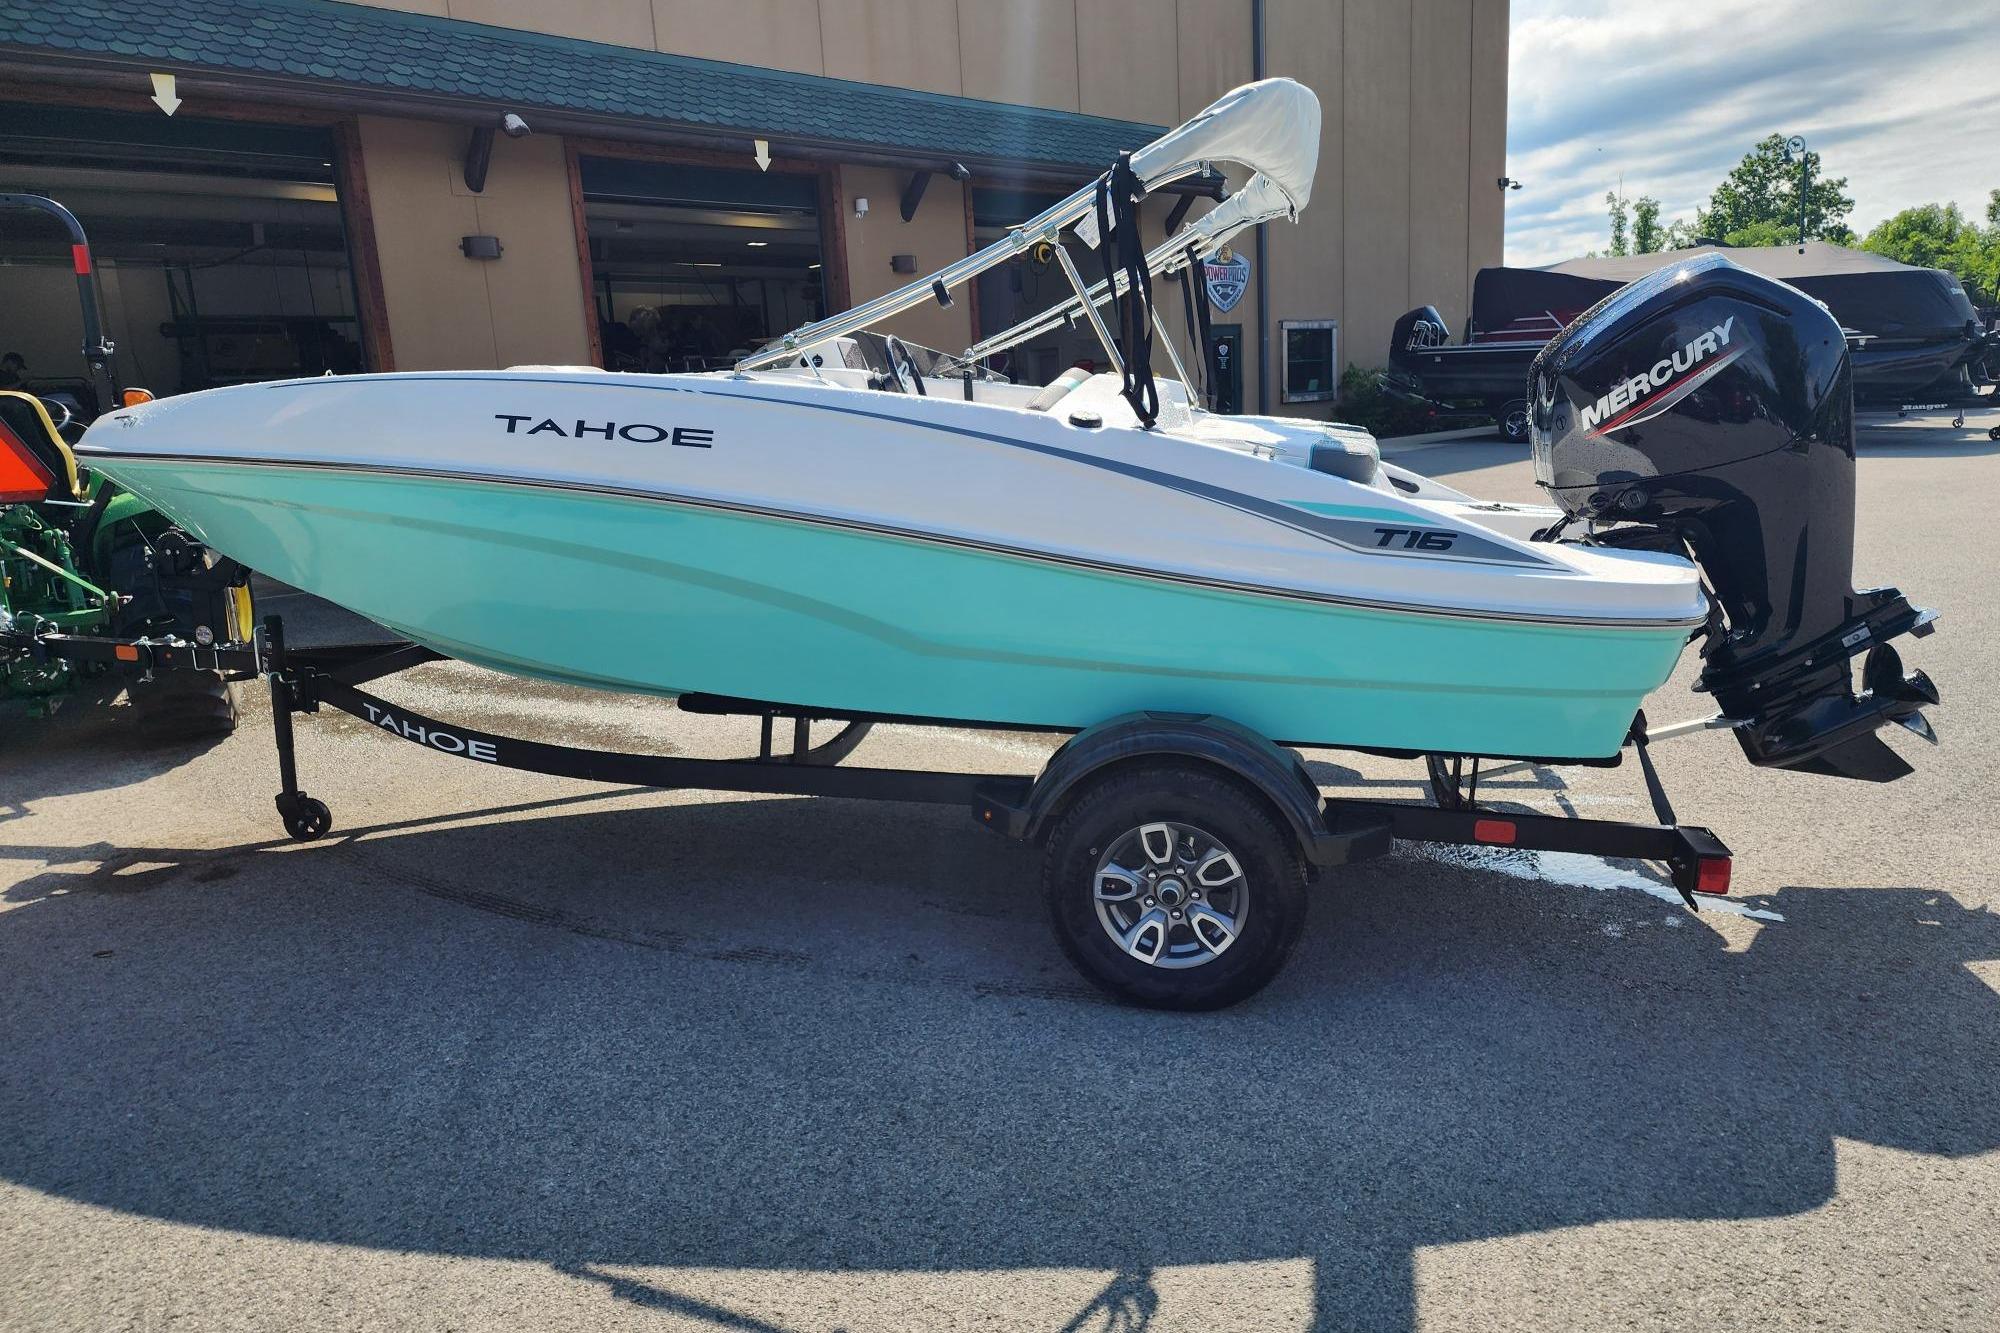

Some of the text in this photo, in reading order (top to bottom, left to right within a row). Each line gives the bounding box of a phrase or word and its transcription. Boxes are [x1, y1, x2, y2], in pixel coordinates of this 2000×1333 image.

[1581, 315, 1734, 431] MERCURY
[1902, 403, 1948, 411] Ranger
[495, 414, 714, 448] TAHOE
[1374, 528, 1458, 550] T16
[363, 702, 497, 762] TAHOE
